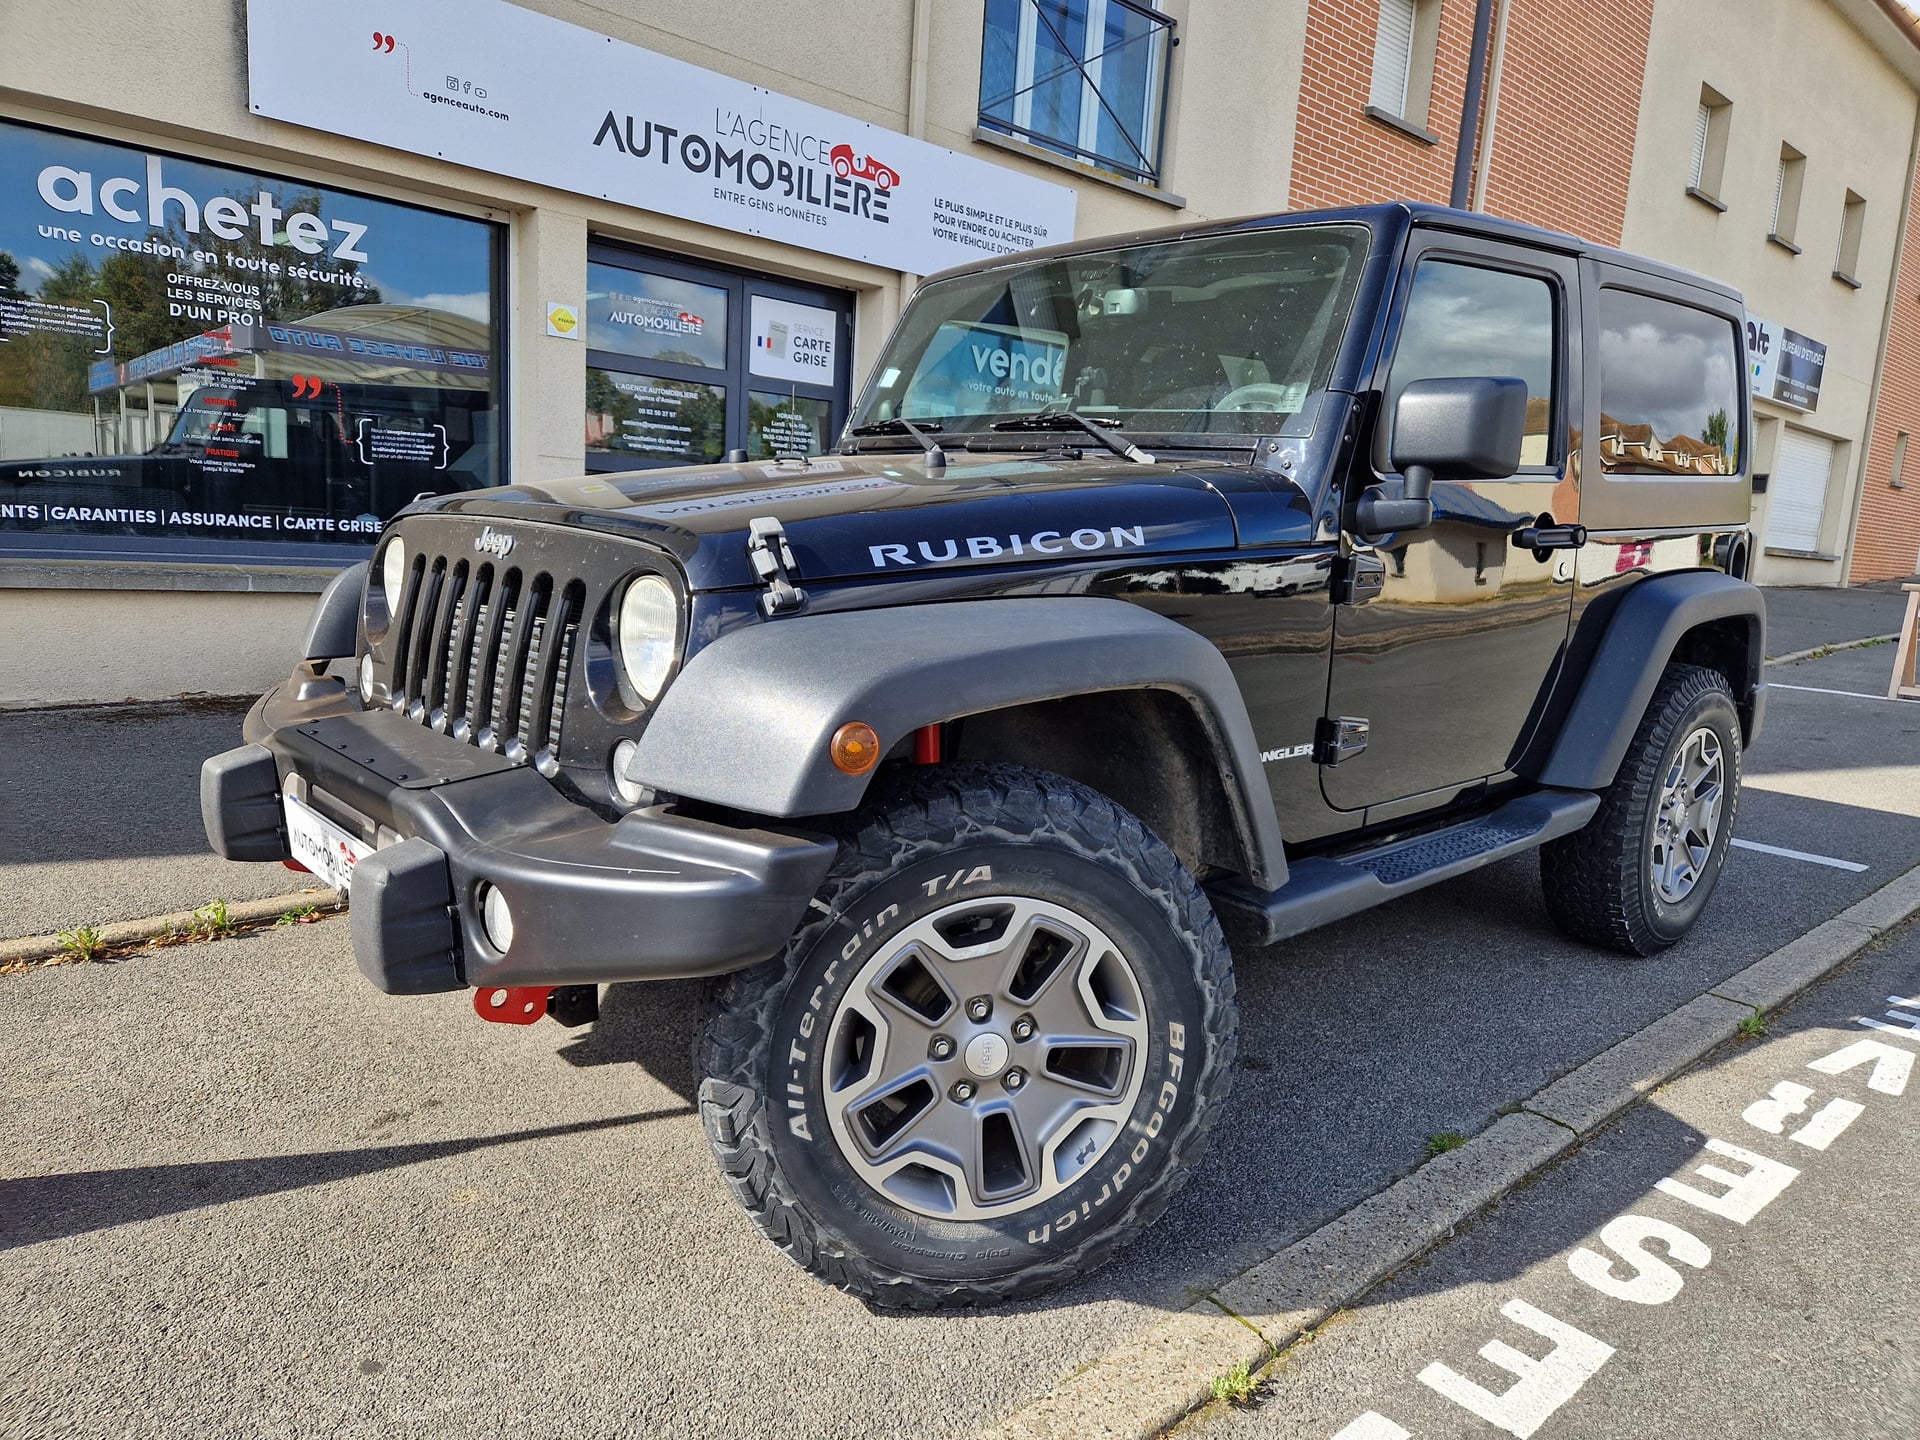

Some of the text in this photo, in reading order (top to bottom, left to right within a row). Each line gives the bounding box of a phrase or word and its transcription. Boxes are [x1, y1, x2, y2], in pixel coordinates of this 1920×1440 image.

[423, 92, 509, 121] agenceauto.com
[714, 107, 831, 166] L'AGENCE
[37, 155, 369, 263] achetez
[714, 187, 828, 226] ENTRE GENS HONNÊTES
[934, 197, 1048, 238] LE PLUS SIMPLE ET LE PLUS SÛR
[933, 212, 1034, 248] POUR VENDRE OU ACHETER
[933, 226, 958, 242] VOTRE
[959, 233, 996, 252] VÉHICULE
[38, 224, 369, 290] une occasion en toute sécurité.
[167, 273, 260, 296] OFFREZ-VOUS
[167, 287, 261, 310] LES SERVICES
[169, 302, 212, 323] D'UN
[217, 308, 255, 327] PRO
[793, 323, 825, 337] SERVICE
[793, 336, 832, 353] CARTE
[793, 351, 828, 367] GRISE
[1781, 339, 1801, 358] BUREAU
[968, 381, 992, 393] votre
[995, 387, 1015, 397] auto
[1018, 390, 1028, 399] en
[189, 457, 203, 465] Vous
[205, 447, 240, 458] PRATIQUE
[0, 504, 383, 533] NTS GARANTIES ASSURANCE CARTE GRISE
[475, 526, 513, 560] Jeep
[868, 525, 1146, 567] RUBICON
[787, 865, 992, 1141] All-Terrain T/A
[1028, 1021, 1186, 1247] BFGoodrich
[1330, 995, 1920, 1440] ESERVE
